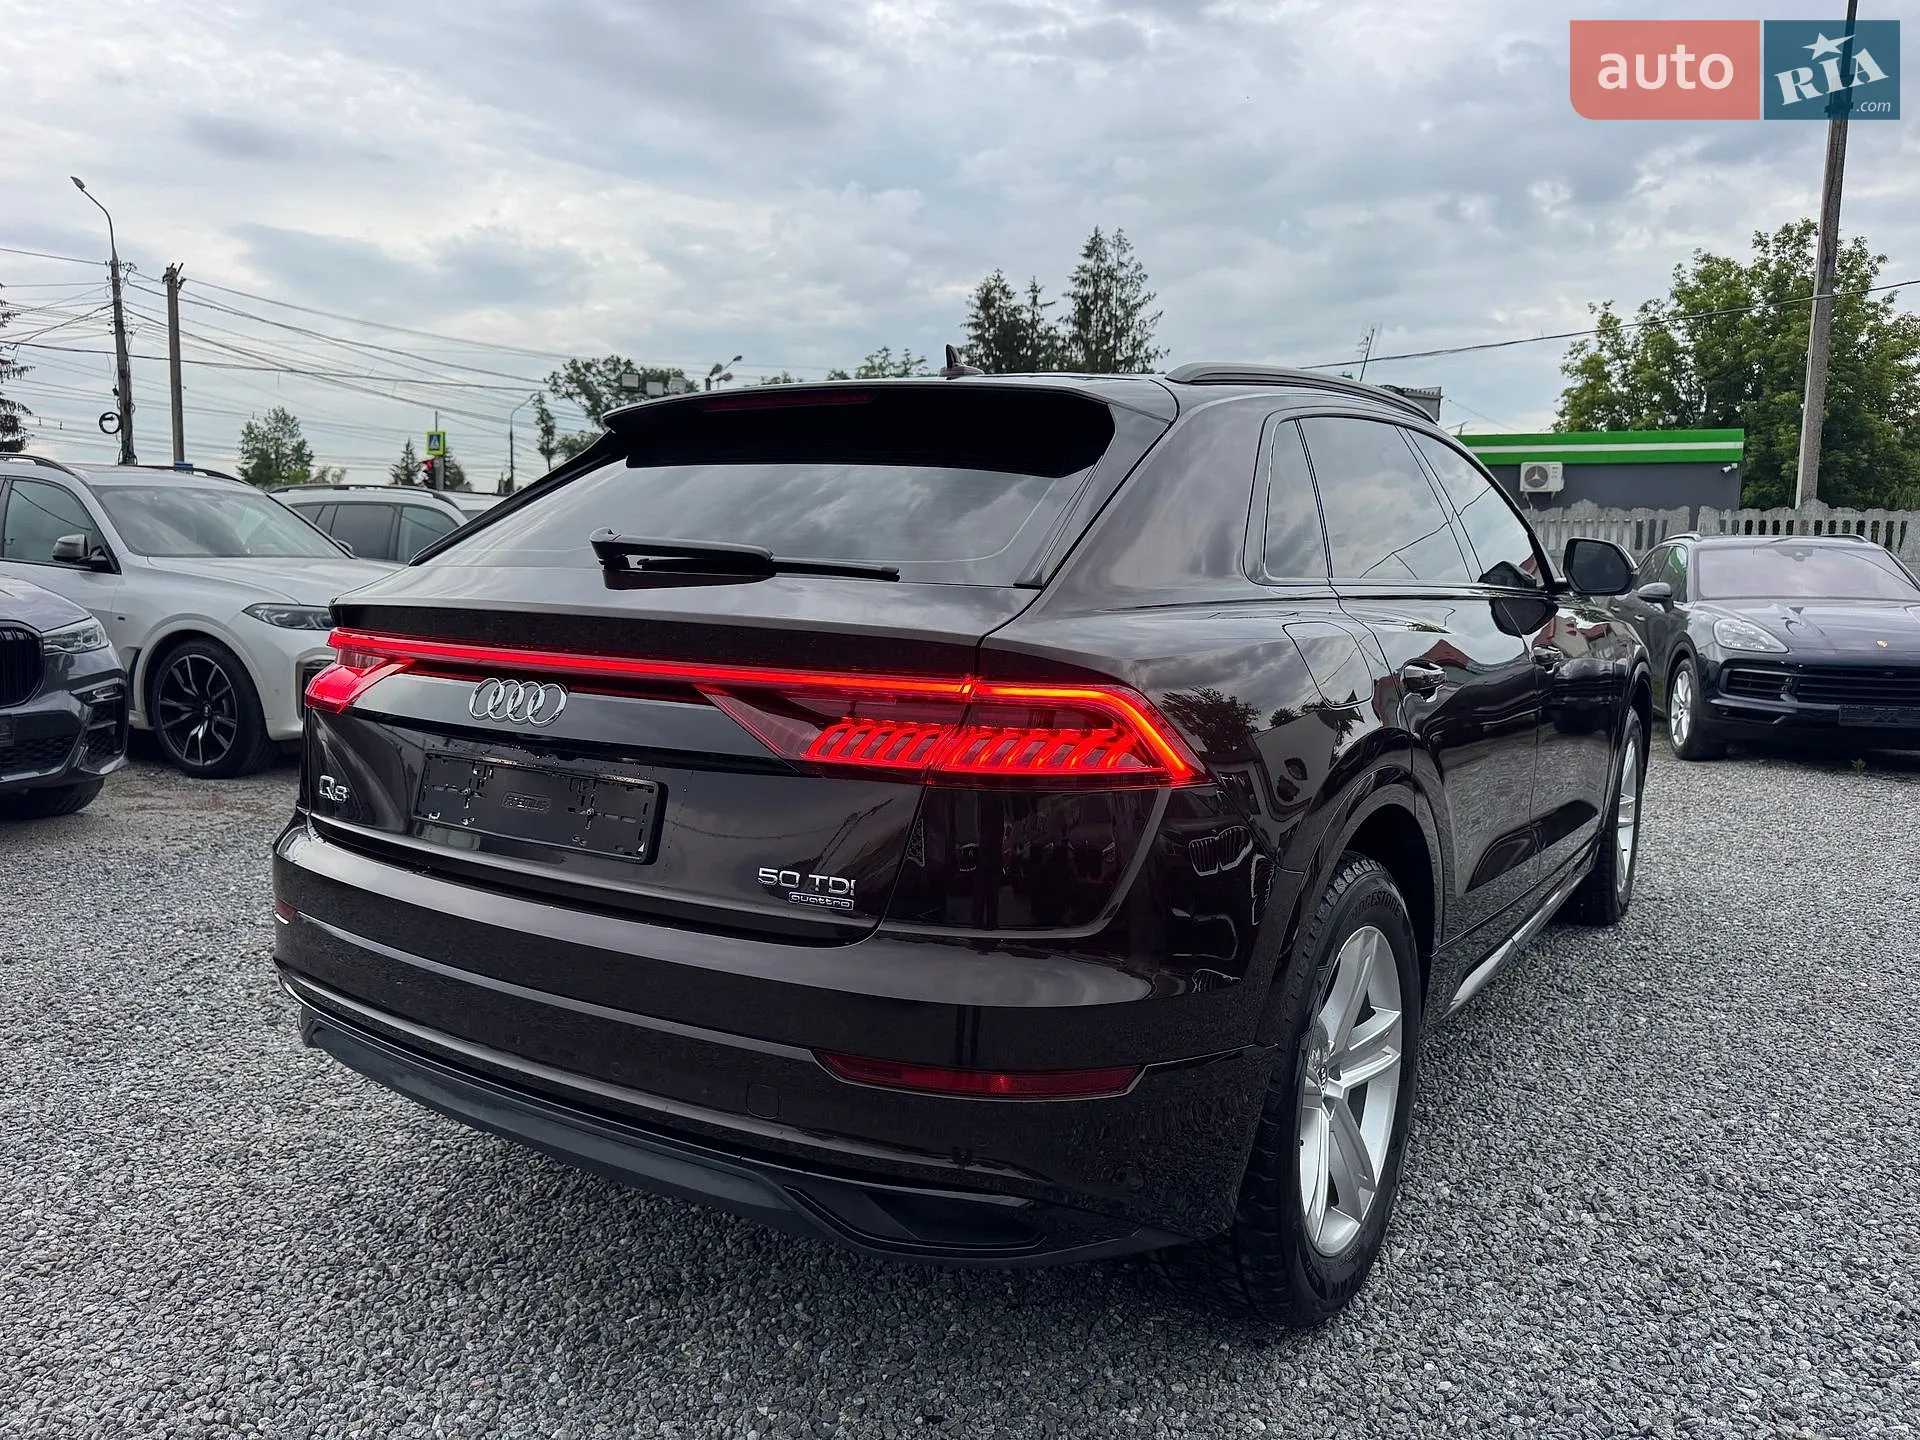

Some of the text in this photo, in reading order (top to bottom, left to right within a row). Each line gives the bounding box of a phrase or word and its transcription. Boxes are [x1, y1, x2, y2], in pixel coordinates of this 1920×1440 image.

[320, 775, 348, 802] Q8
[757, 867, 856, 896] 50 TDI
[790, 893, 851, 909] quattro
[1345, 889, 1402, 921] IDGESTONE
